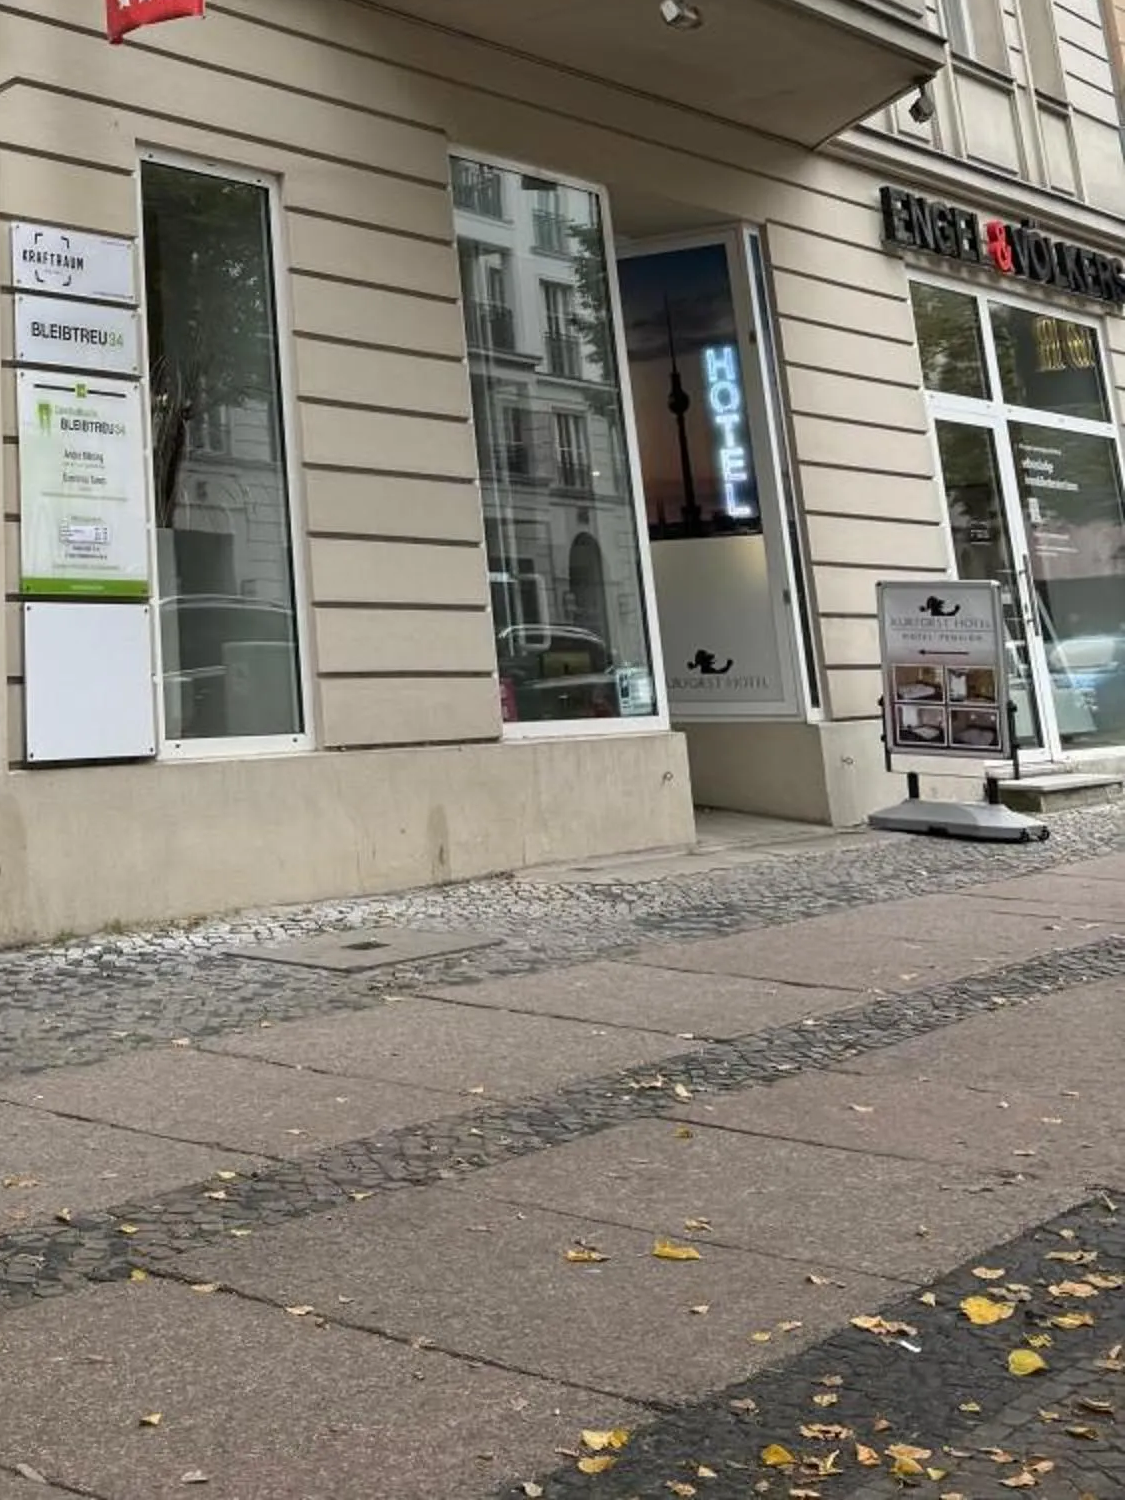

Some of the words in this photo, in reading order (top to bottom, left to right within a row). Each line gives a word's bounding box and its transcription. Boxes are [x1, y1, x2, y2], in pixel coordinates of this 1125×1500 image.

[22, 249, 84, 271] KRAFTRAUM
[987, 220, 1015, 275] &
[31, 321, 124, 348] BLEIBTREU34
[706, 346, 752, 518] HOTEL
